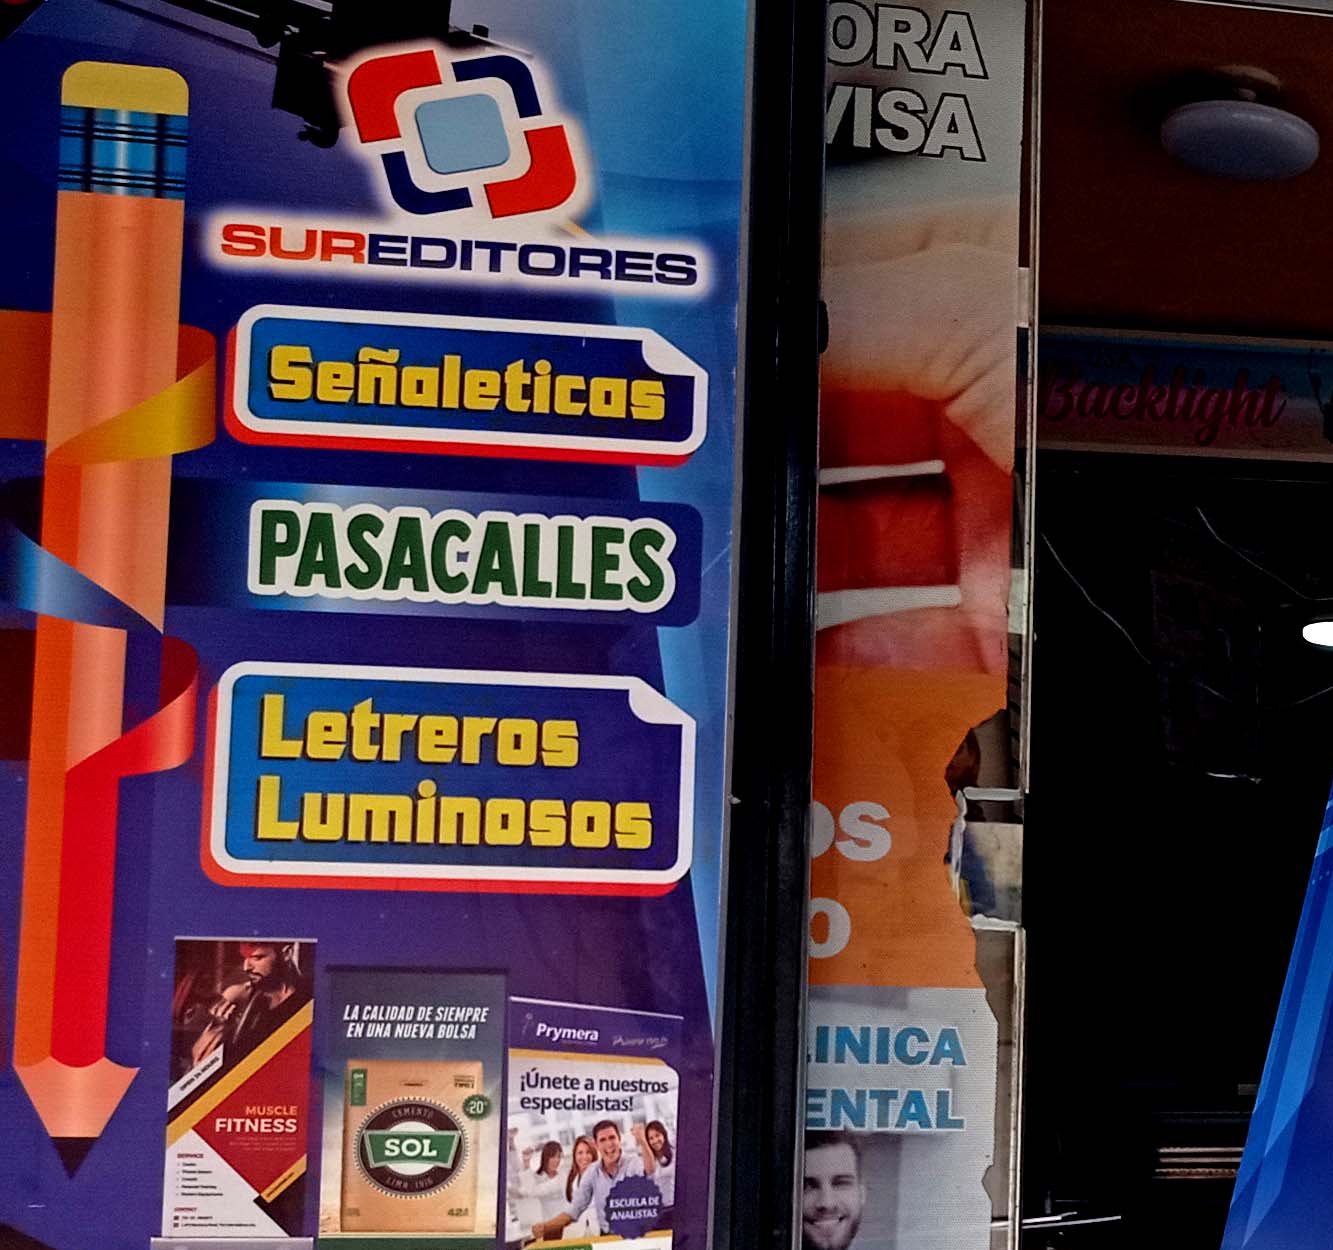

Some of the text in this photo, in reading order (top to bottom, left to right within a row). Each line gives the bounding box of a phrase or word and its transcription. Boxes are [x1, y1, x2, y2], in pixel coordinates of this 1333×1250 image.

[220, 223, 698, 287] SUREDITORES
[268, 345, 666, 420] Señaleticas
[258, 508, 668, 602] PASACALLES
[259, 693, 580, 767] Letreros
[255, 775, 653, 850] Luminosos
[343, 1004, 489, 1023] LA CALIDAD DE SIEMPRE
[346, 1022, 477, 1040] EN UNA NUEVA BOLSA
[536, 1023, 599, 1042] Prymera
[807, 1025, 966, 1066] INICA
[520, 1067, 669, 1093] ¡Únete a nuestros
[245, 1105, 298, 1116] MUSCLE
[520, 1094, 634, 1115] especialistas!
[215, 1118, 298, 1133] FITNESS
[384, 1138, 437, 1157] SOL
[609, 1196, 660, 1209] ESCUELA DE
[610, 1209, 658, 1221] ANALISTAS
